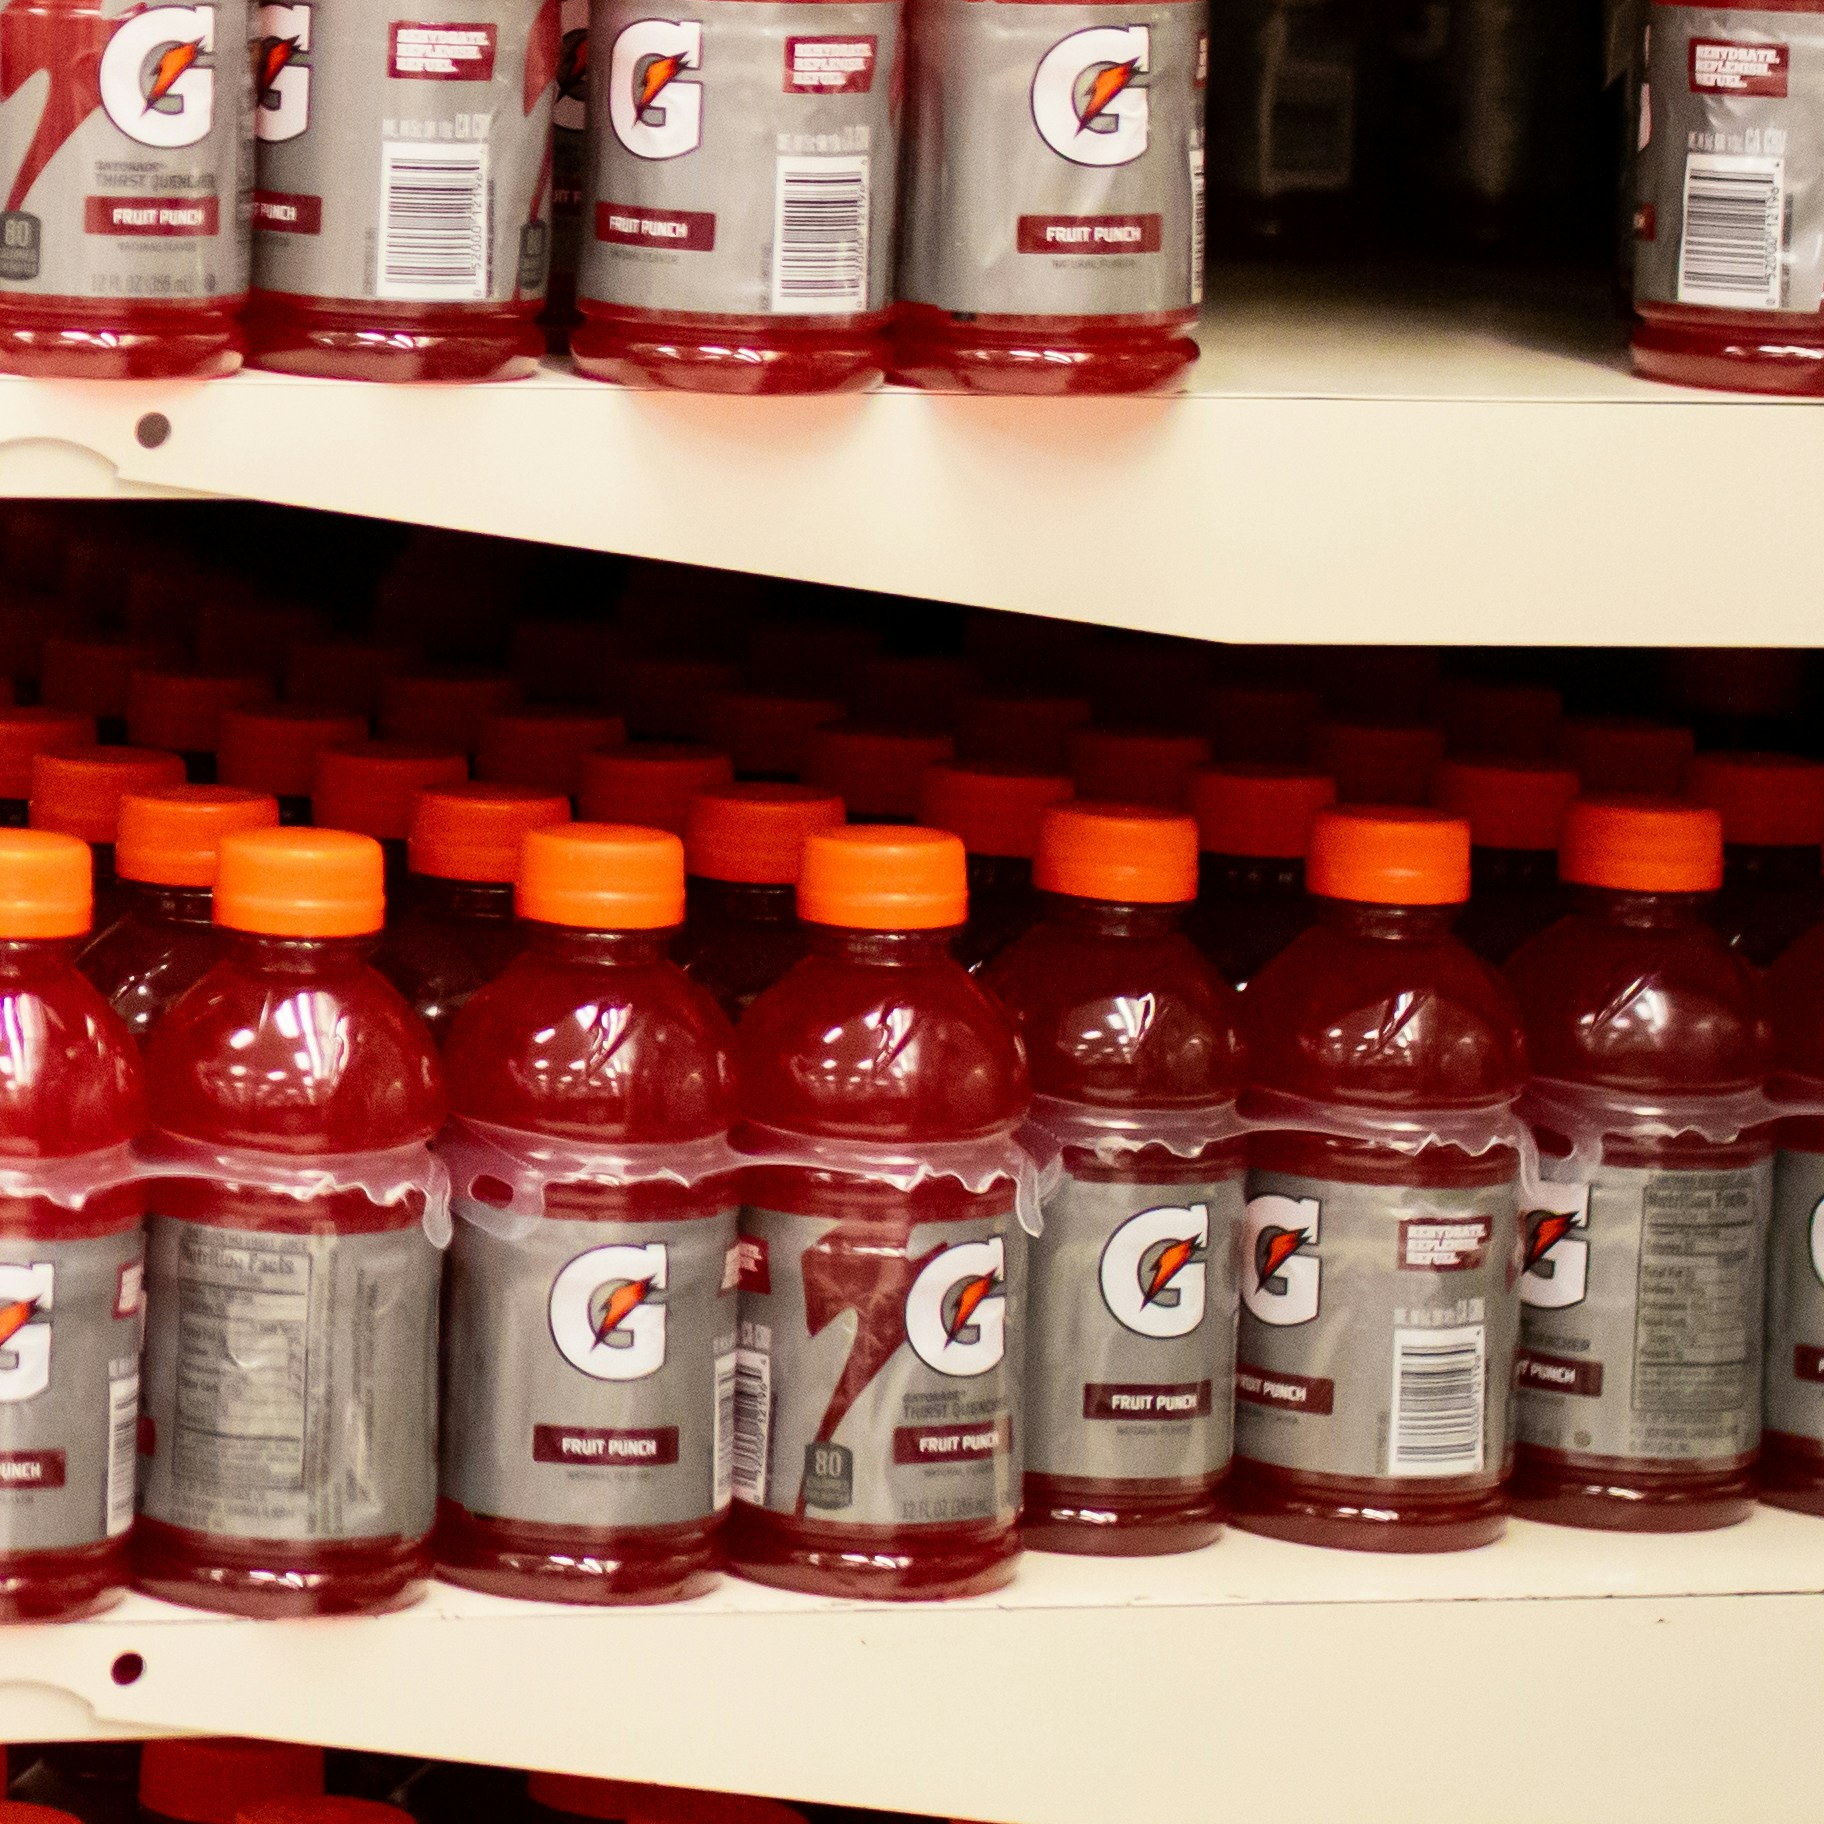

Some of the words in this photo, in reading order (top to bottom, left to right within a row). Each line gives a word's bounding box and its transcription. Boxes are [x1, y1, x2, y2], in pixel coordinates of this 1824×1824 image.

[1695, 44, 1780, 64] REHYDRATE.
[99, 3, 215, 150] G
[609, 17, 703, 162] G
[1030, 23, 1151, 168] G
[112, 207, 156, 226] FRUIT
[159, 208, 205, 227] PUNCH
[261, 203, 297, 222] PUNCH
[4, 219, 30, 246] 80
[1046, 227, 1091, 243] FRUIT
[1094, 226, 1142, 242] PUNCH
[471, 225, 483, 270] 52000
[1518, 1179, 1592, 1309] G
[1099, 1202, 1210, 1339] G
[1241, 1193, 1323, 1326] G
[548, 1241, 669, 1382] G
[905, 1235, 1006, 1377] G
[1530, 1363, 1576, 1384] PUNCH
[1111, 1394, 1153, 1410] FRUIT
[1156, 1394, 1198, 1410] PUNCH
[1263, 1381, 1307, 1402] PUNCH
[562, 1437, 605, 1455] FRUIT
[608, 1439, 657, 1456] PUNCH
[919, 1435, 959, 1453] FRUIT
[962, 1432, 1000, 1450] PUNCH
[814, 1449, 842, 1476] 80
